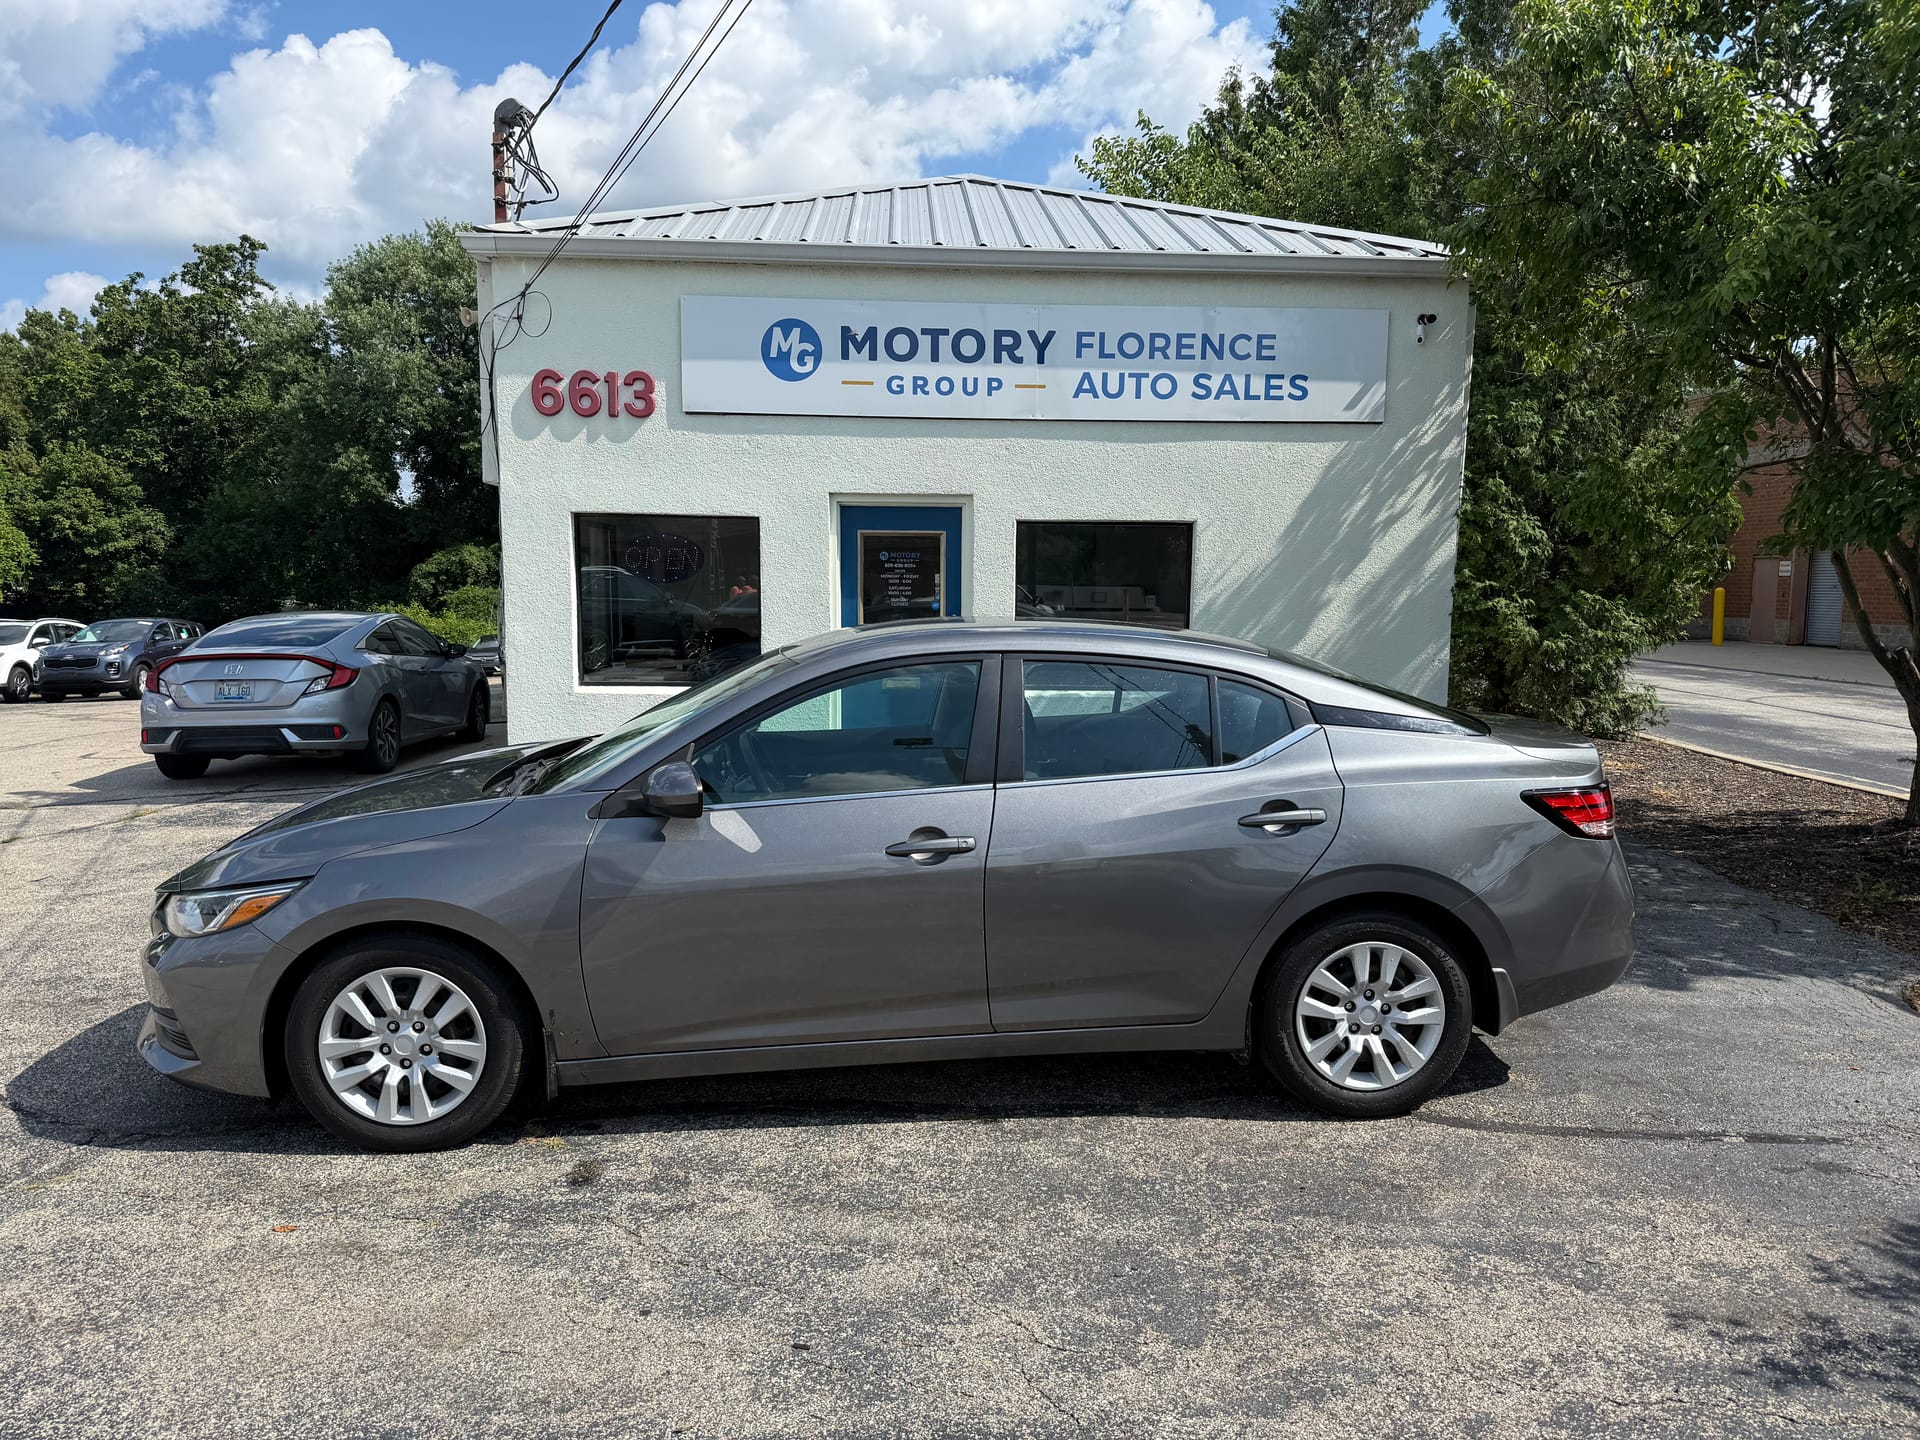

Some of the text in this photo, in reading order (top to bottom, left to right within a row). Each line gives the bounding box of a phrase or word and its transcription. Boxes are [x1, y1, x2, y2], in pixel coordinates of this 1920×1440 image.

[768, 326, 817, 374] MG
[840, 325, 1057, 366] MOTORY
[1074, 330, 1277, 362] FLORENCE
[531, 368, 656, 418] 6613
[885, 374, 1004, 397] GROUP
[1072, 371, 1309, 401] AUTO SALES
[625, 546, 699, 571] OPEN
[218, 686, 251, 696] ALX 160
